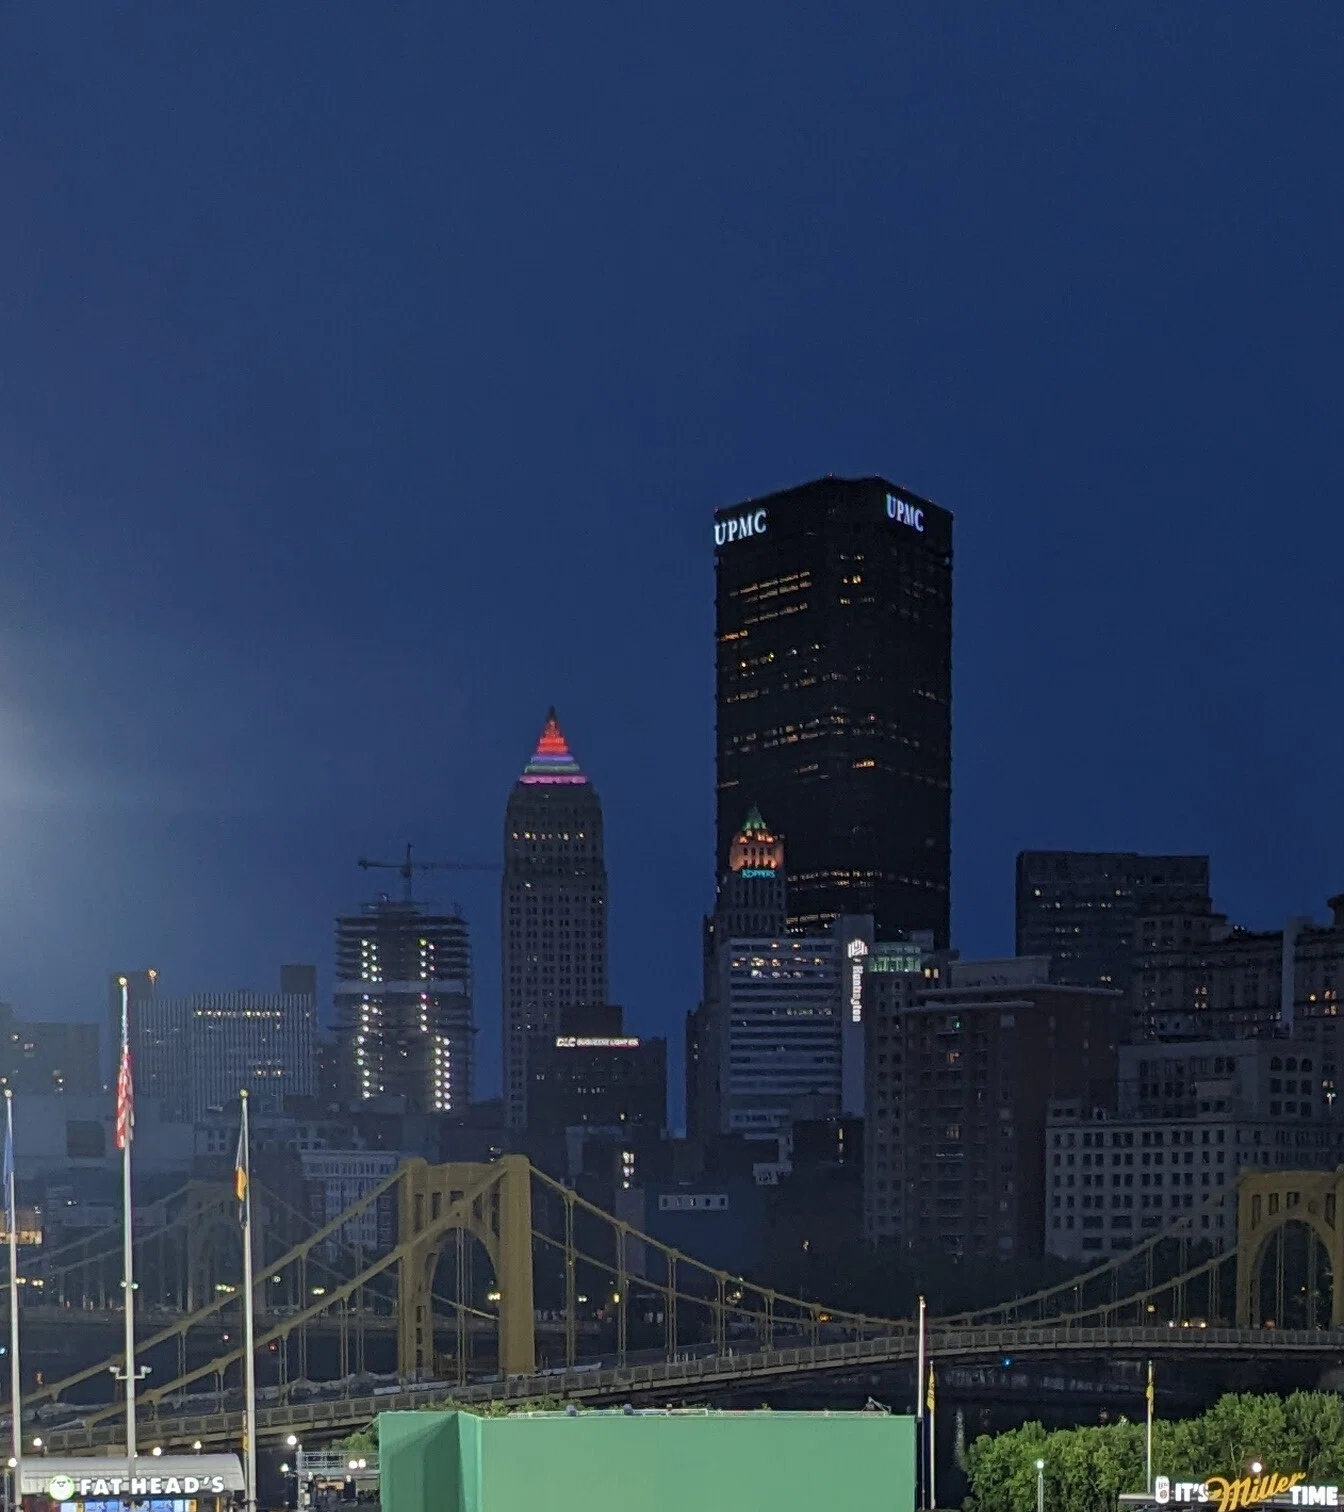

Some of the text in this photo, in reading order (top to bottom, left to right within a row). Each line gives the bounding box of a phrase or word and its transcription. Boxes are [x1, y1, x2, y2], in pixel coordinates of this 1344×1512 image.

[886, 492, 924, 532] UPMC
[714, 510, 767, 546] UPMC
[80, 1476, 225, 1496] FAT HEAD'S
[1175, 1483, 1209, 1503] IT'S
[1290, 1486, 1338, 1506] TIME
